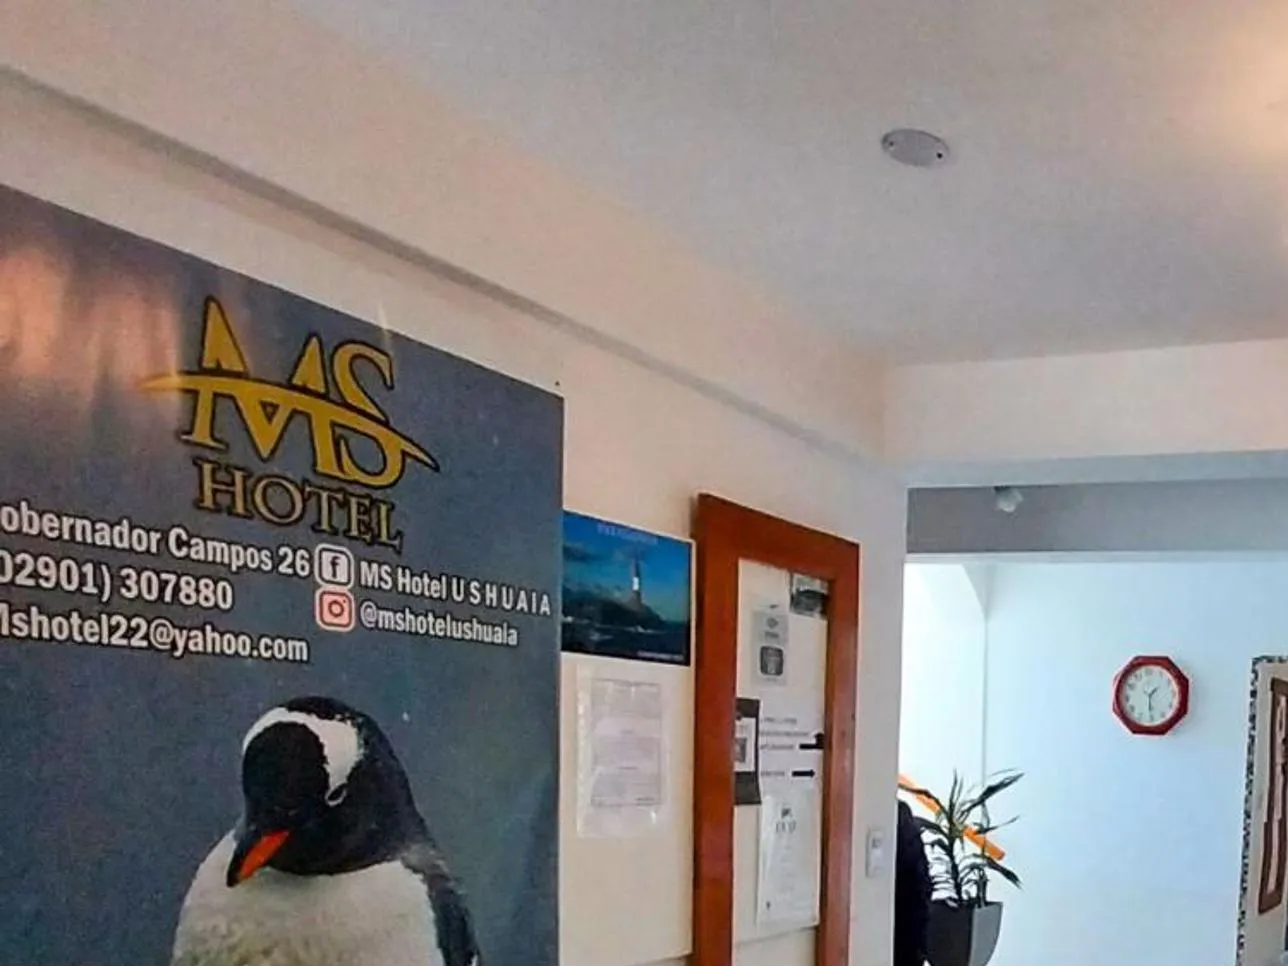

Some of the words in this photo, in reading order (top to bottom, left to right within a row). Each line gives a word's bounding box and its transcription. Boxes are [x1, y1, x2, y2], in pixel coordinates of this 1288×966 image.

[195, 457, 403, 551] HOTEL
[0, 501, 161, 553] obernador
[168, 527, 272, 571] Campos
[278, 547, 310, 577] 26
[0, 549, 110, 601] 02901)
[120, 567, 233, 610] 307880
[360, 561, 392, 590] MS
[398, 567, 447, 600] Hotel
